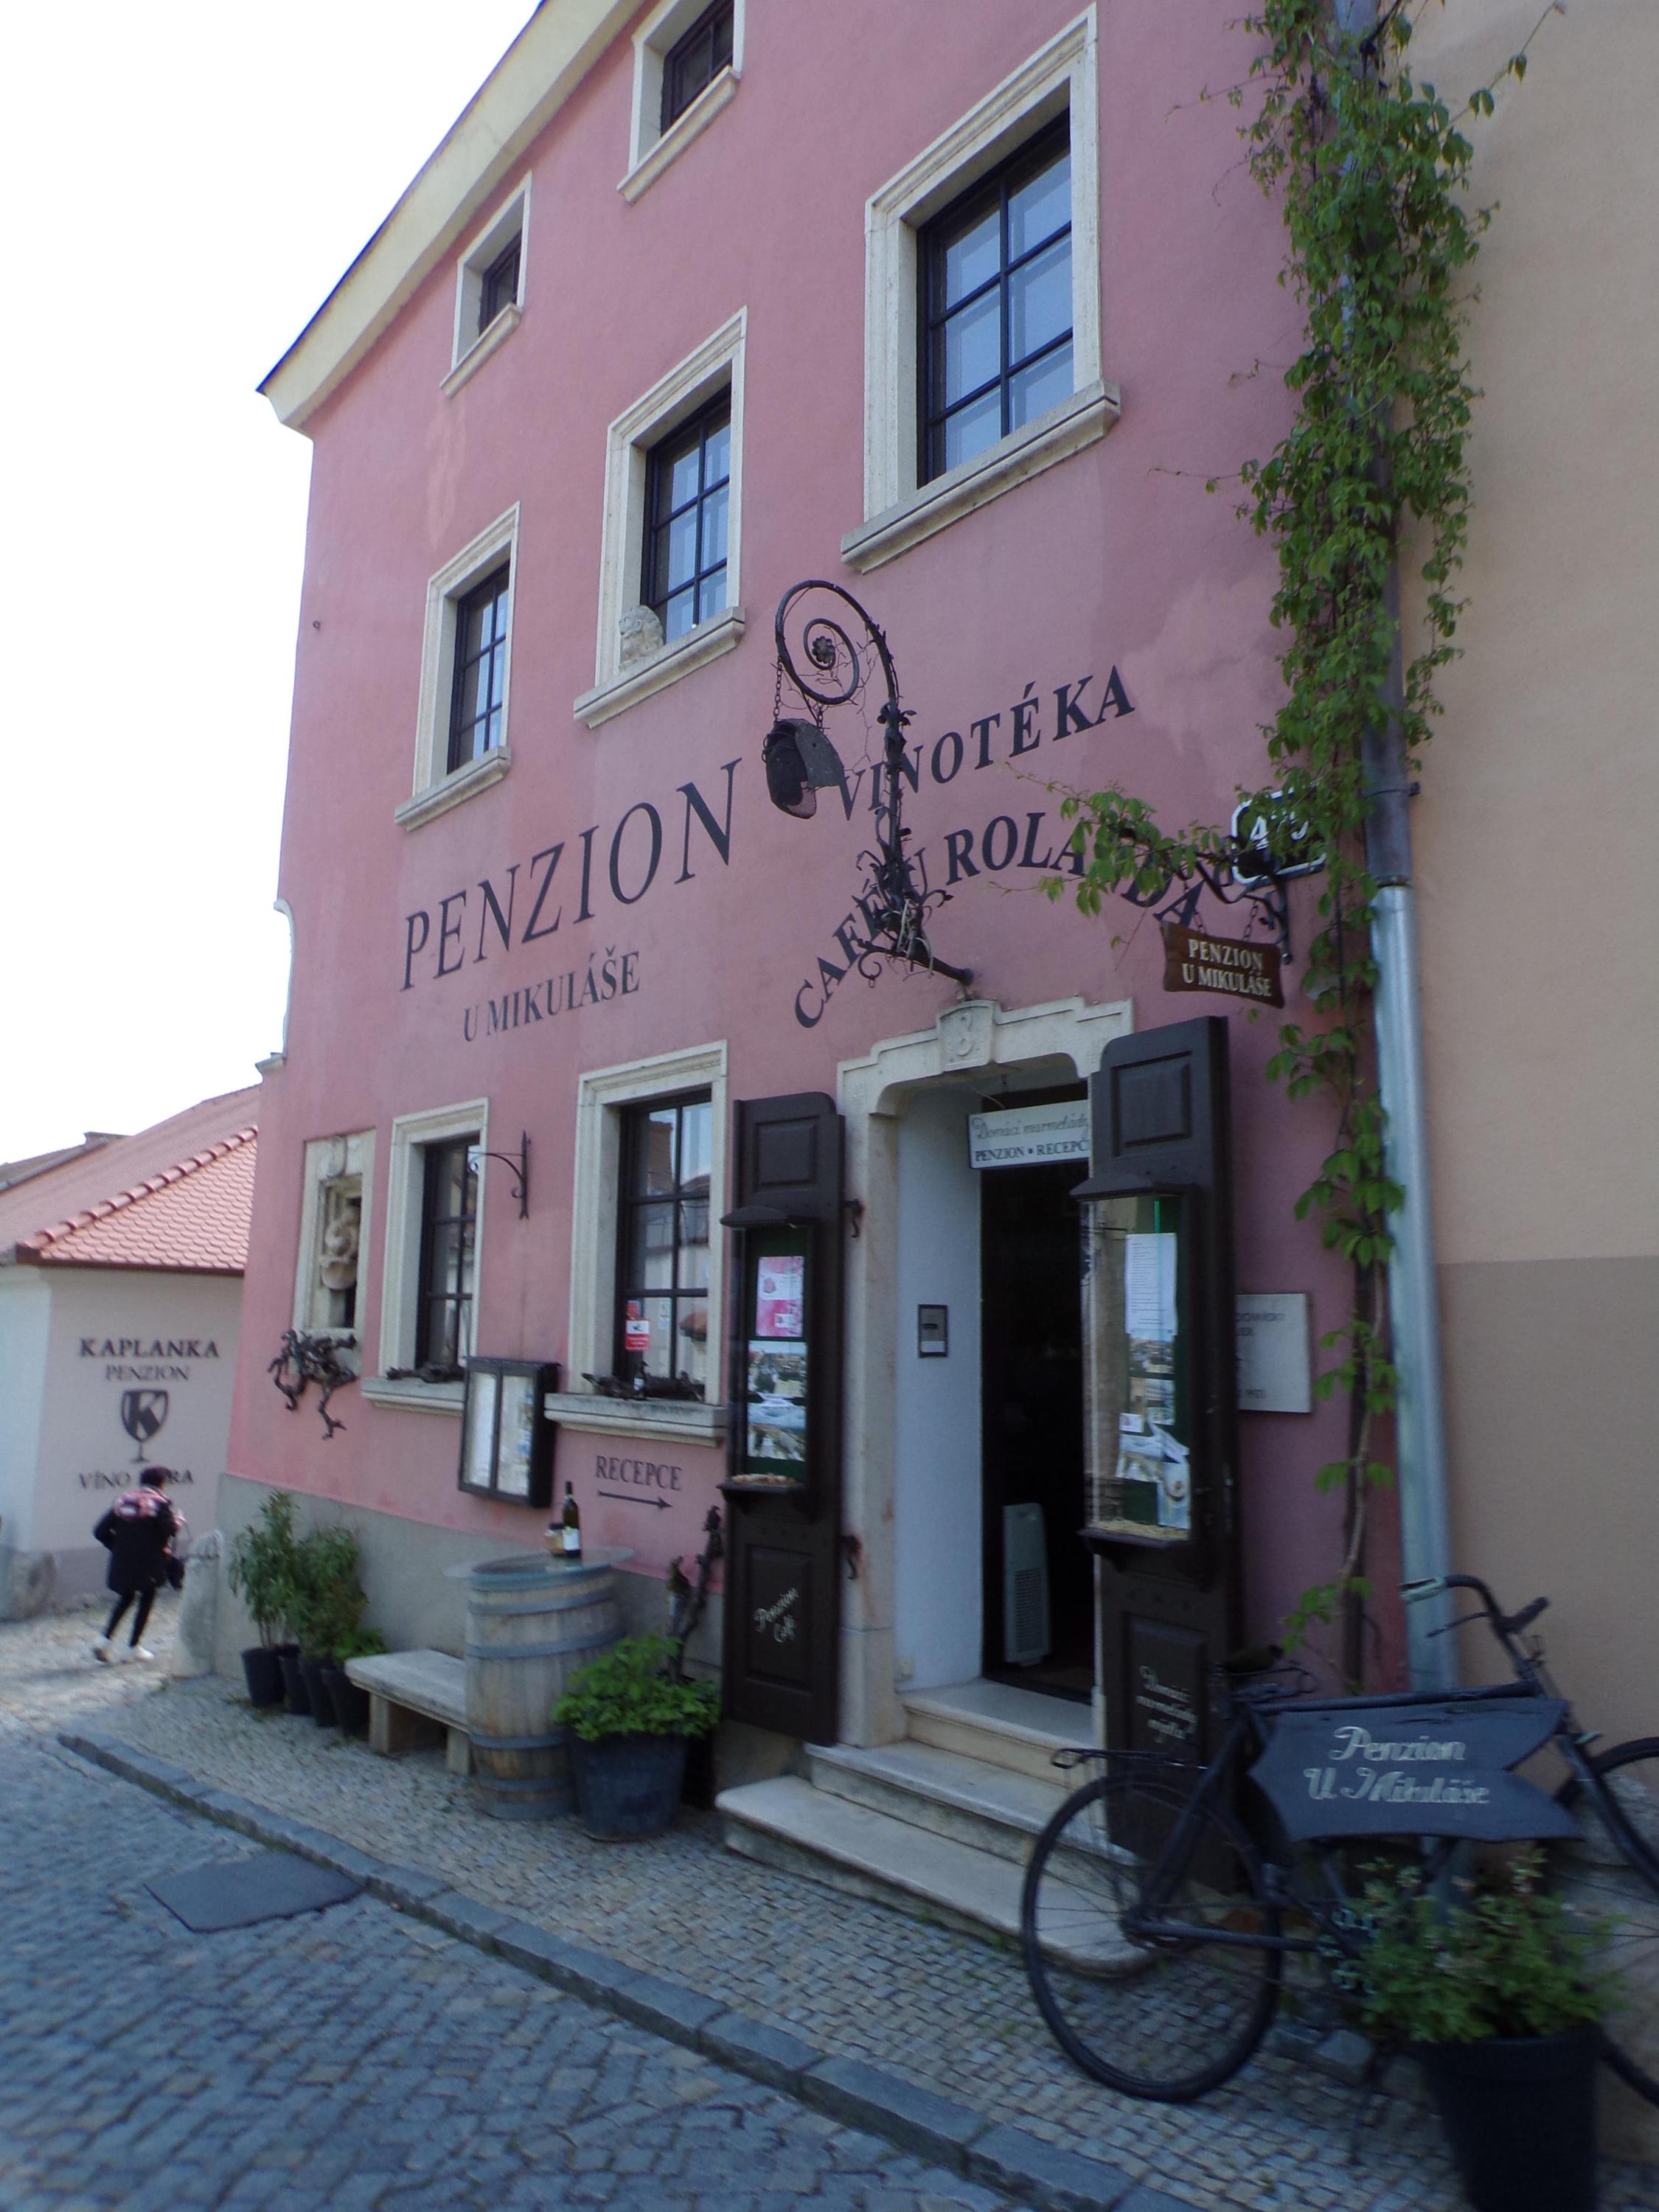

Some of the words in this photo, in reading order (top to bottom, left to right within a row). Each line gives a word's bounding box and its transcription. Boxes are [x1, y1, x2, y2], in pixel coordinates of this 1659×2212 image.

[839, 665, 1135, 821] VINOTÉKA
[400, 757, 742, 992] PENZION
[943, 813, 1206, 928] ROLADA
[1188, 939, 1263, 971] PENZION
[463, 1006, 484, 1043] U
[487, 945, 640, 1036] MIKULÁŠE
[1181, 963, 1195, 984] U
[1197, 965, 1273, 997] MIKULÁŠE
[975, 1145, 1026, 1162] PENZION
[1036, 1139, 1089, 1155] RECEPC
[79, 1338, 220, 1358] KAPLANKA
[105, 1364, 189, 1381] PENZION
[596, 1455, 682, 1492] RECEPCE
[1330, 1725, 1466, 1761] Penzion
[1304, 1767, 1336, 1801] U
[1340, 1767, 1490, 1804] Mikuláše
